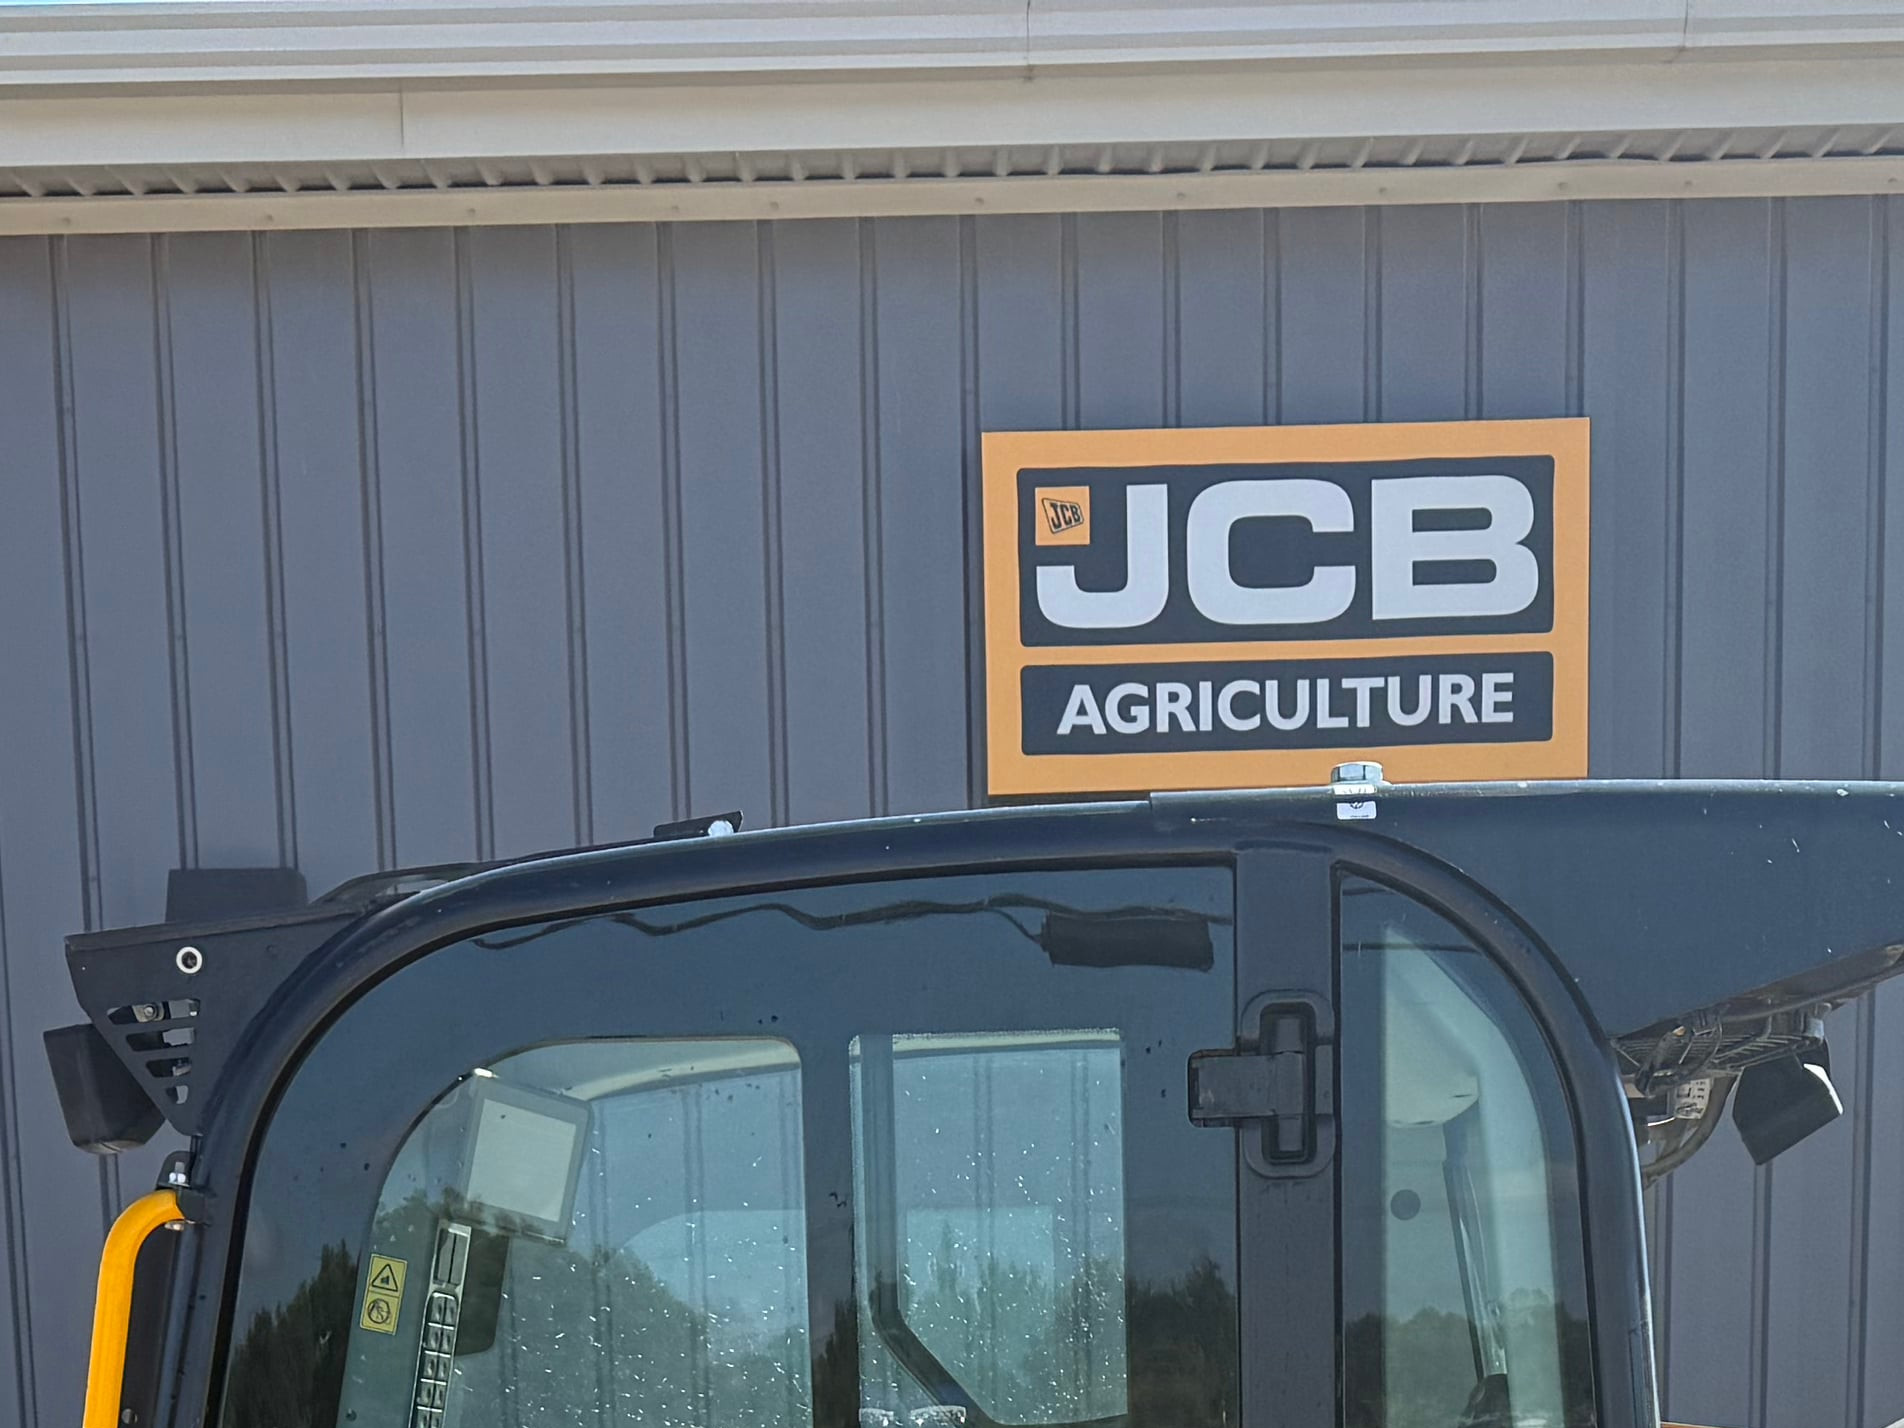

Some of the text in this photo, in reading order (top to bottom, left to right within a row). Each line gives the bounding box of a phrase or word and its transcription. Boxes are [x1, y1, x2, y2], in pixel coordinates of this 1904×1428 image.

[1050, 502, 1081, 529] JCB
[1036, 475, 1539, 629] JCB
[1056, 673, 1514, 735] AGRICULTURE
